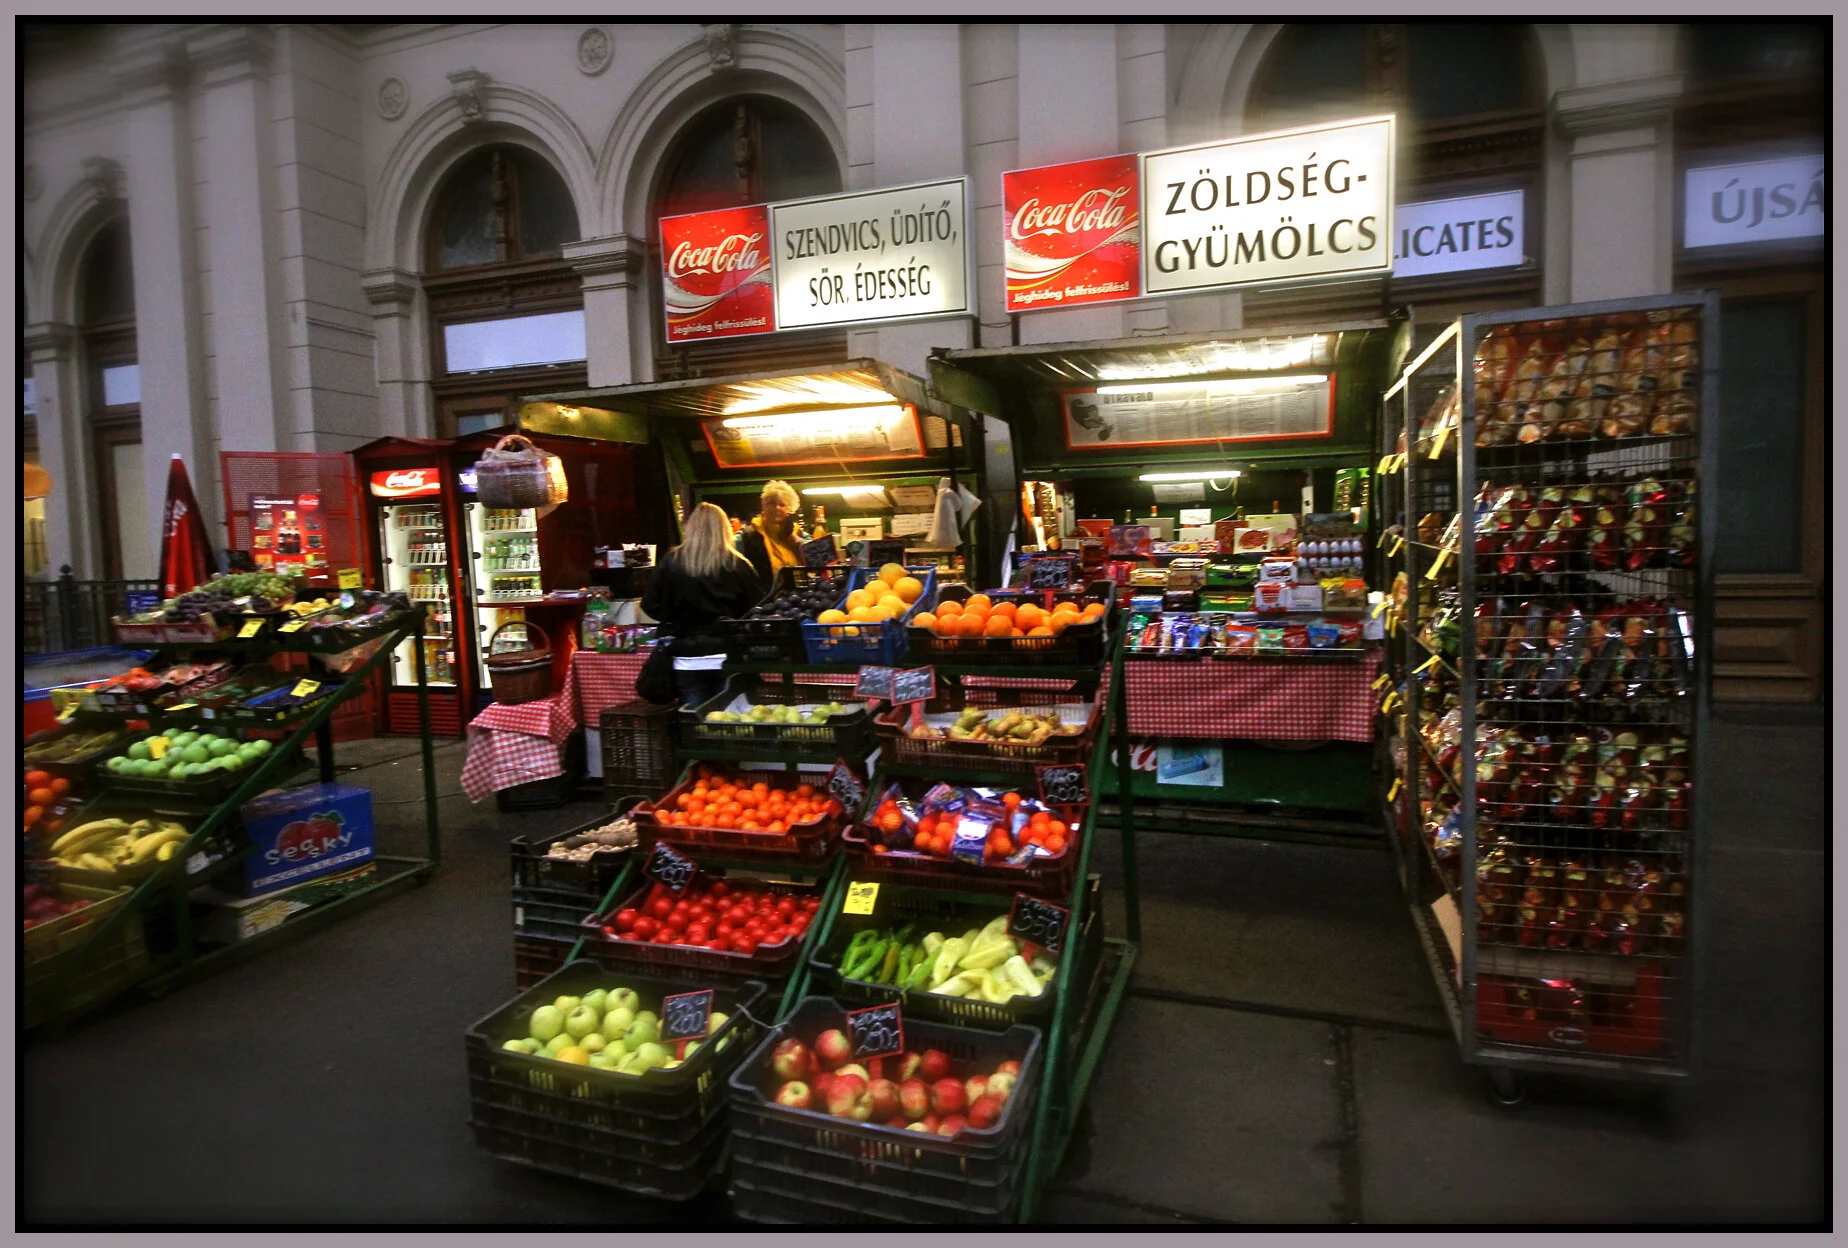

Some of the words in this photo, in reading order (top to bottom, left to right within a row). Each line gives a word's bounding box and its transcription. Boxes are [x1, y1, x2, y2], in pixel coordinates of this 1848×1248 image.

[1164, 152, 1368, 217] ZÖLDSÉG-
[786, 216, 886, 261] SZENDVICS,
[891, 200, 958, 248] ÜDÍTŐ,
[1010, 186, 1132, 240] Coca-Cola
[1393, 214, 1514, 260] ICATES
[669, 232, 764, 279] Coca-Cola
[1154, 216, 1377, 274] GYÜMÖLCS
[856, 256, 931, 303] ÉDESSÉG
